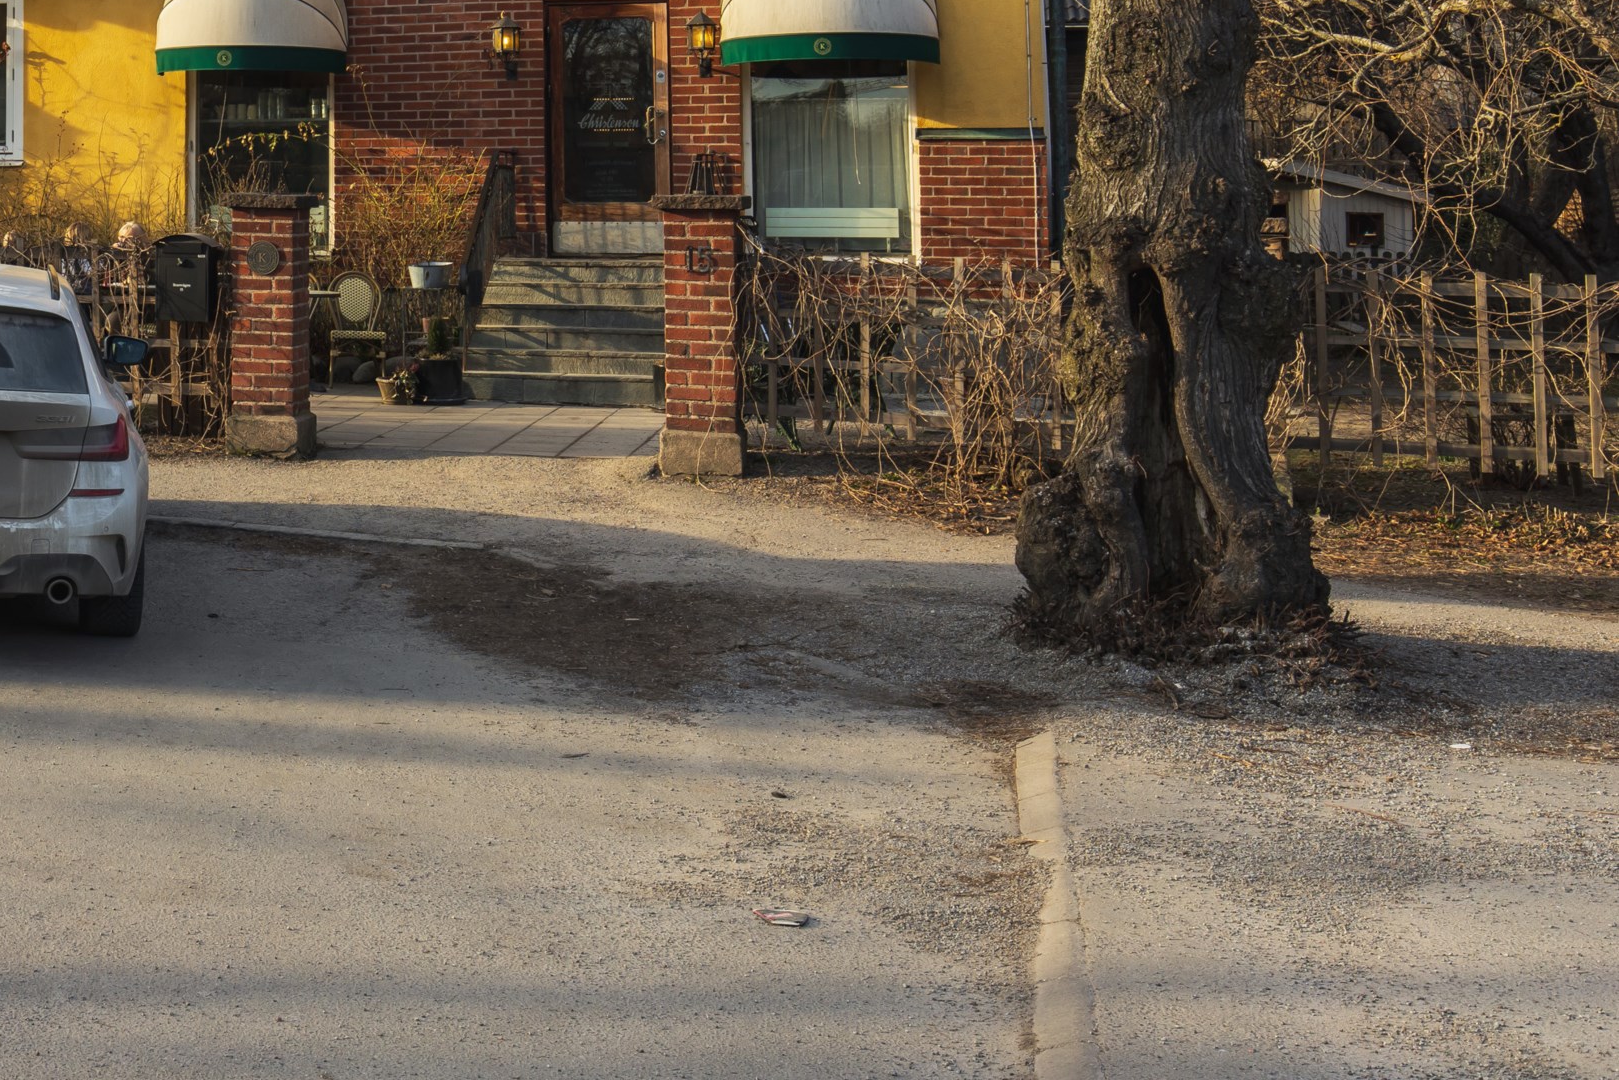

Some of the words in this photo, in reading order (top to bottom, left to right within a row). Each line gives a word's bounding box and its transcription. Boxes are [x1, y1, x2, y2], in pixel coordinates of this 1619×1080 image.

[577, 113, 639, 129] Christenson
[257, 252, 267, 263] K
[685, 245, 711, 273] 15
